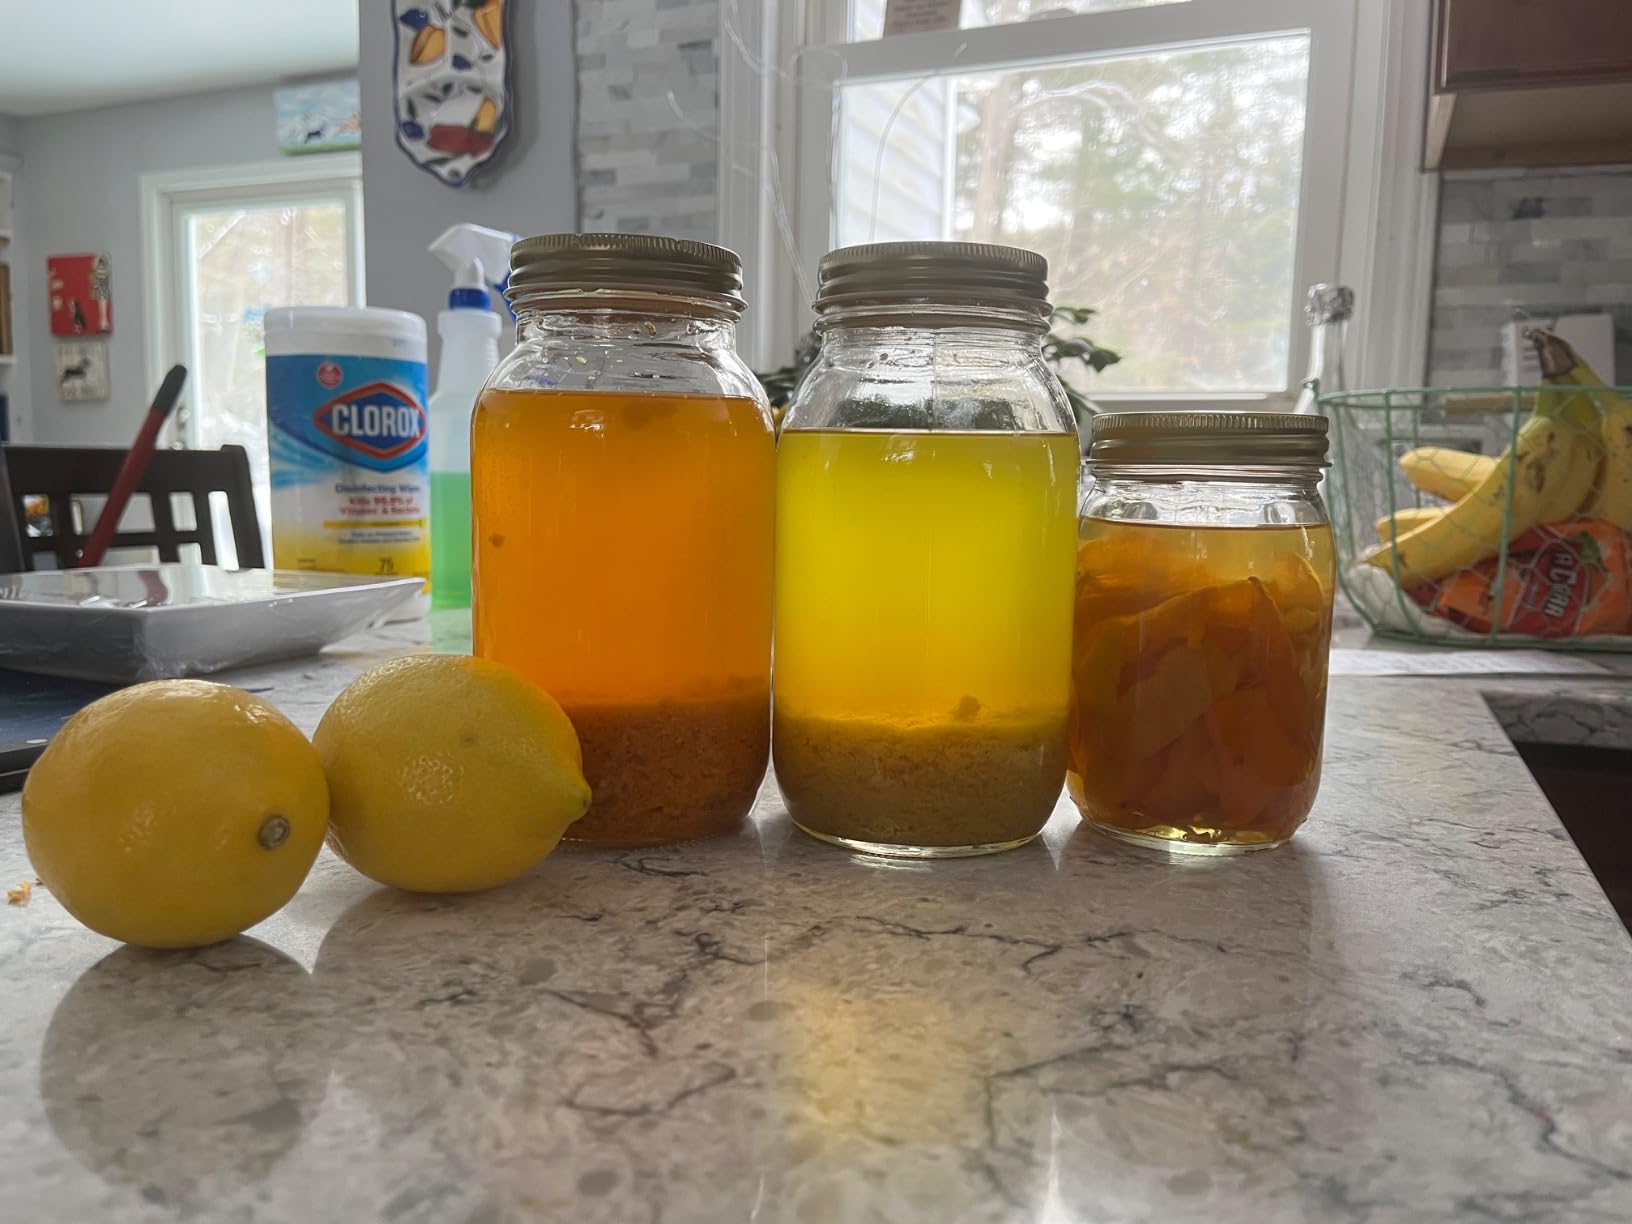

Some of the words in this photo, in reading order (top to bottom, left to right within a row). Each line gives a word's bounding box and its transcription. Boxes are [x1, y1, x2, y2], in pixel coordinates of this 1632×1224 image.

[331, 403, 420, 438] CLOROX
[335, 482, 397, 494] Disinfecting
[380, 557, 394, 571] 75
